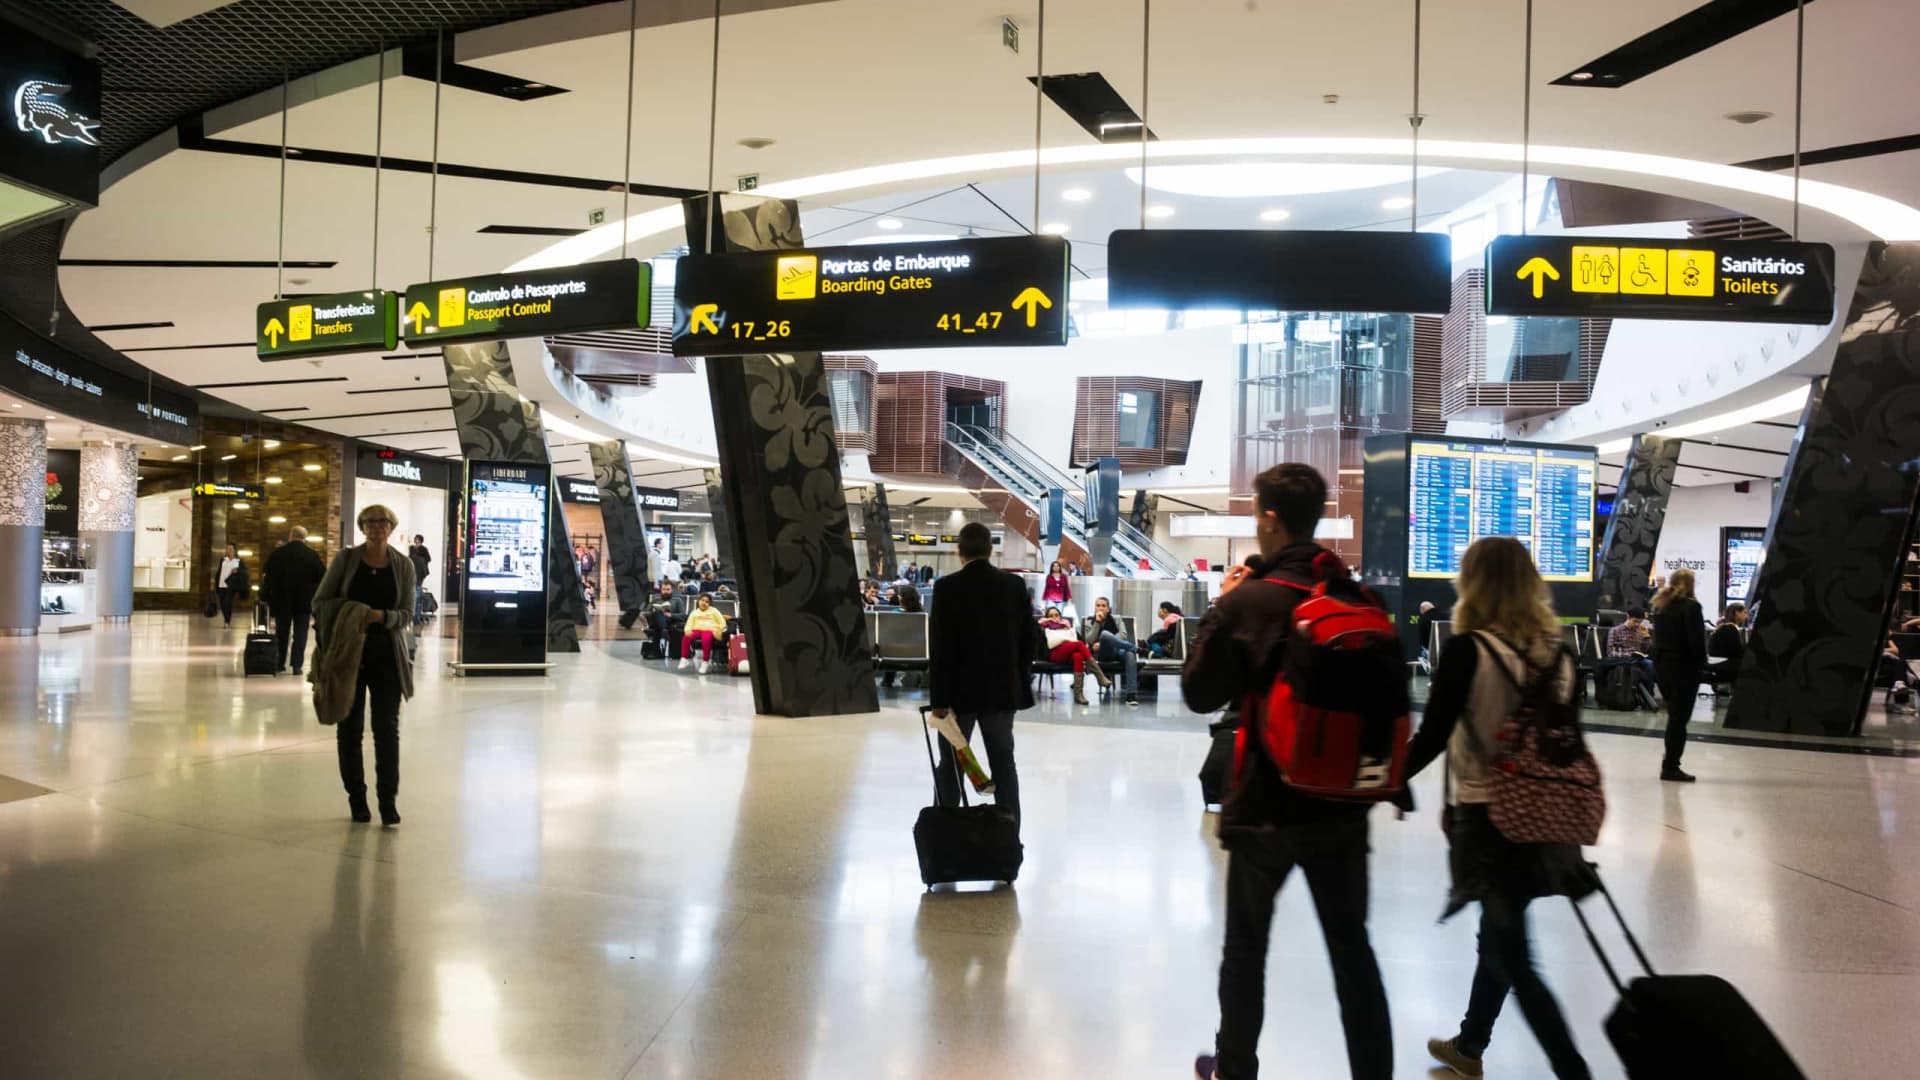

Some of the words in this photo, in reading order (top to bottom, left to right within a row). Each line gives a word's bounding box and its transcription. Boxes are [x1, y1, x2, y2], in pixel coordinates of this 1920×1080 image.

[821, 257, 868, 275] Portas
[873, 256, 891, 271] de
[894, 252, 971, 272] Embarque
[1721, 256, 1805, 275] Sanitários
[467, 286, 510, 304] Controlo
[511, 284, 525, 299] de
[525, 280, 587, 299] Passaportes
[821, 277, 886, 295] Boarding
[889, 275, 932, 290] Gates
[1721, 277, 1779, 295] Toilets
[314, 302, 376, 320] Transferências
[467, 303, 510, 321] Passport
[512, 299, 552, 317] Control
[314, 320, 353, 336] Transfers
[731, 320, 791, 341] 17_26
[936, 311, 1003, 334] 41_47
[382, 460, 421, 481] PANDORA
